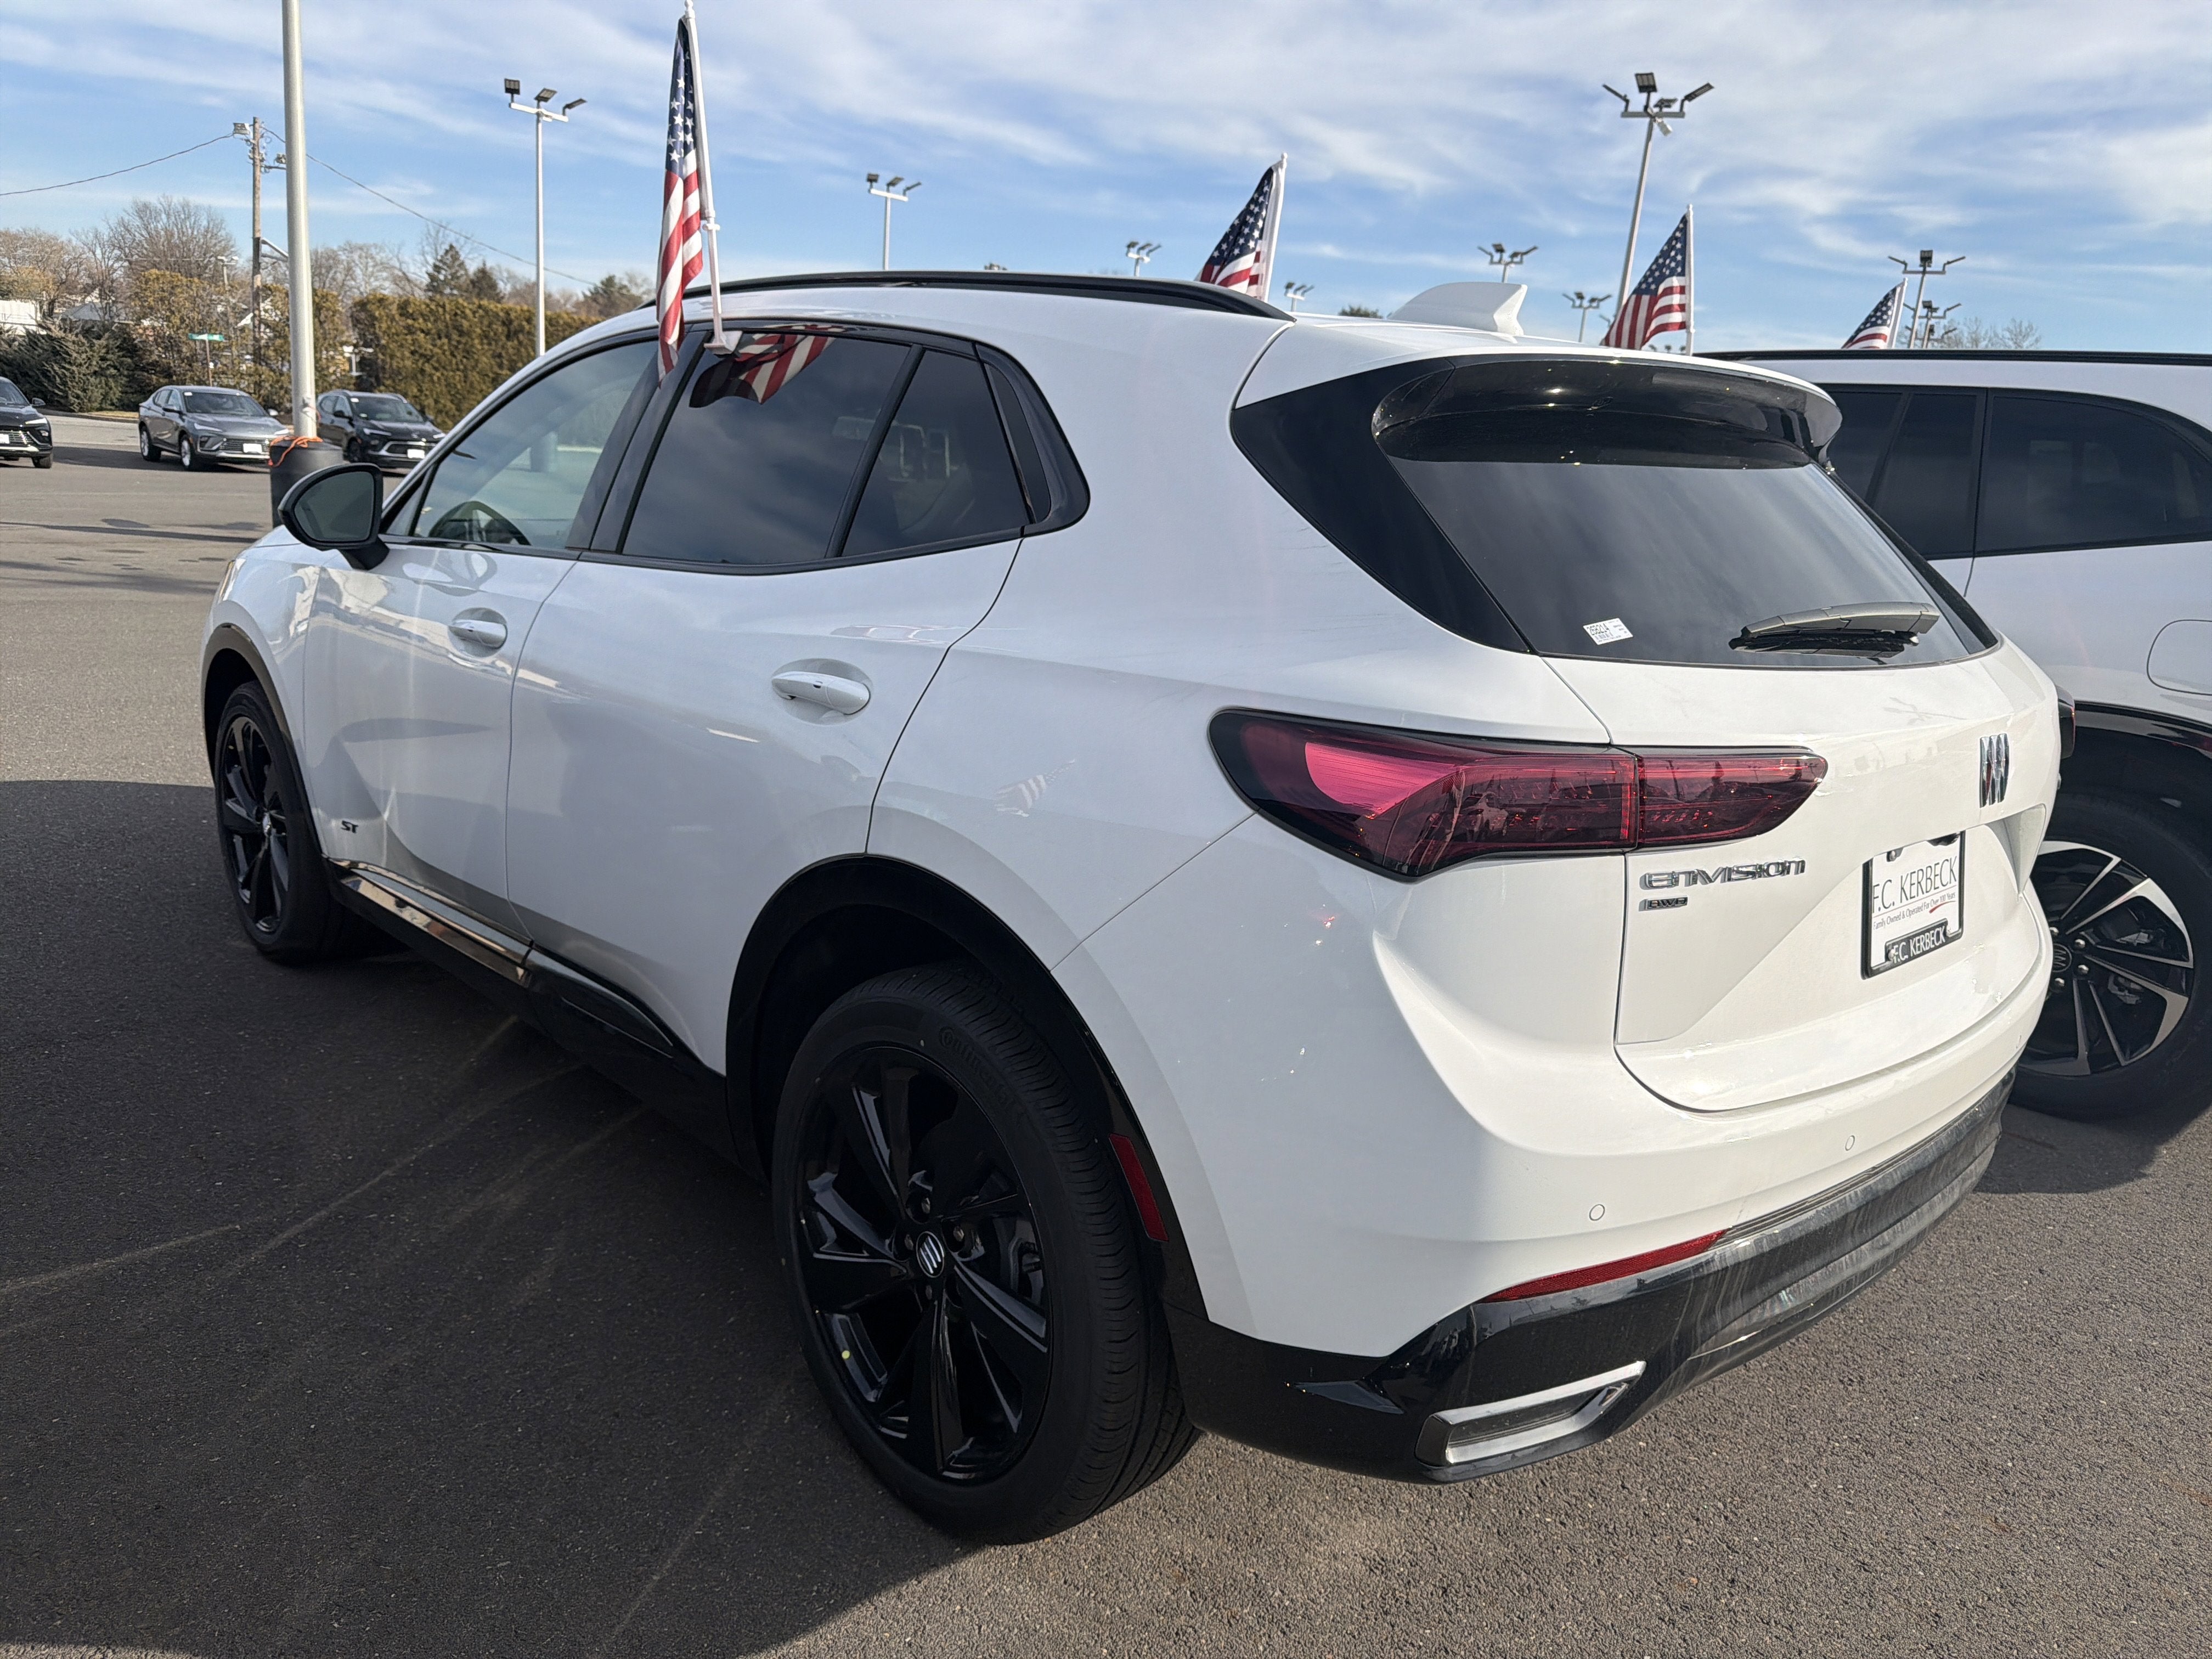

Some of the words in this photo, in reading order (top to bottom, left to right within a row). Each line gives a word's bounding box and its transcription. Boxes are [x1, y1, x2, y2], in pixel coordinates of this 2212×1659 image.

[341, 820, 359, 833] ST
[1640, 857, 1806, 890] ENVISION
[1872, 879, 1894, 913] F.C.
[1900, 856, 1957, 903] KERBECK
[1647, 897, 1688, 909] AWD
[1874, 919, 1886, 930] Family
[1887, 911, 1901, 925] Owned
[1902, 910, 1905, 919] &
[1906, 902, 1923, 918] Operated
[1930, 898, 1939, 907] Over
[1946, 891, 1956, 900] Years
[1893, 941, 1908, 964] F.C.
[1910, 926, 1945, 957] KERBECK
